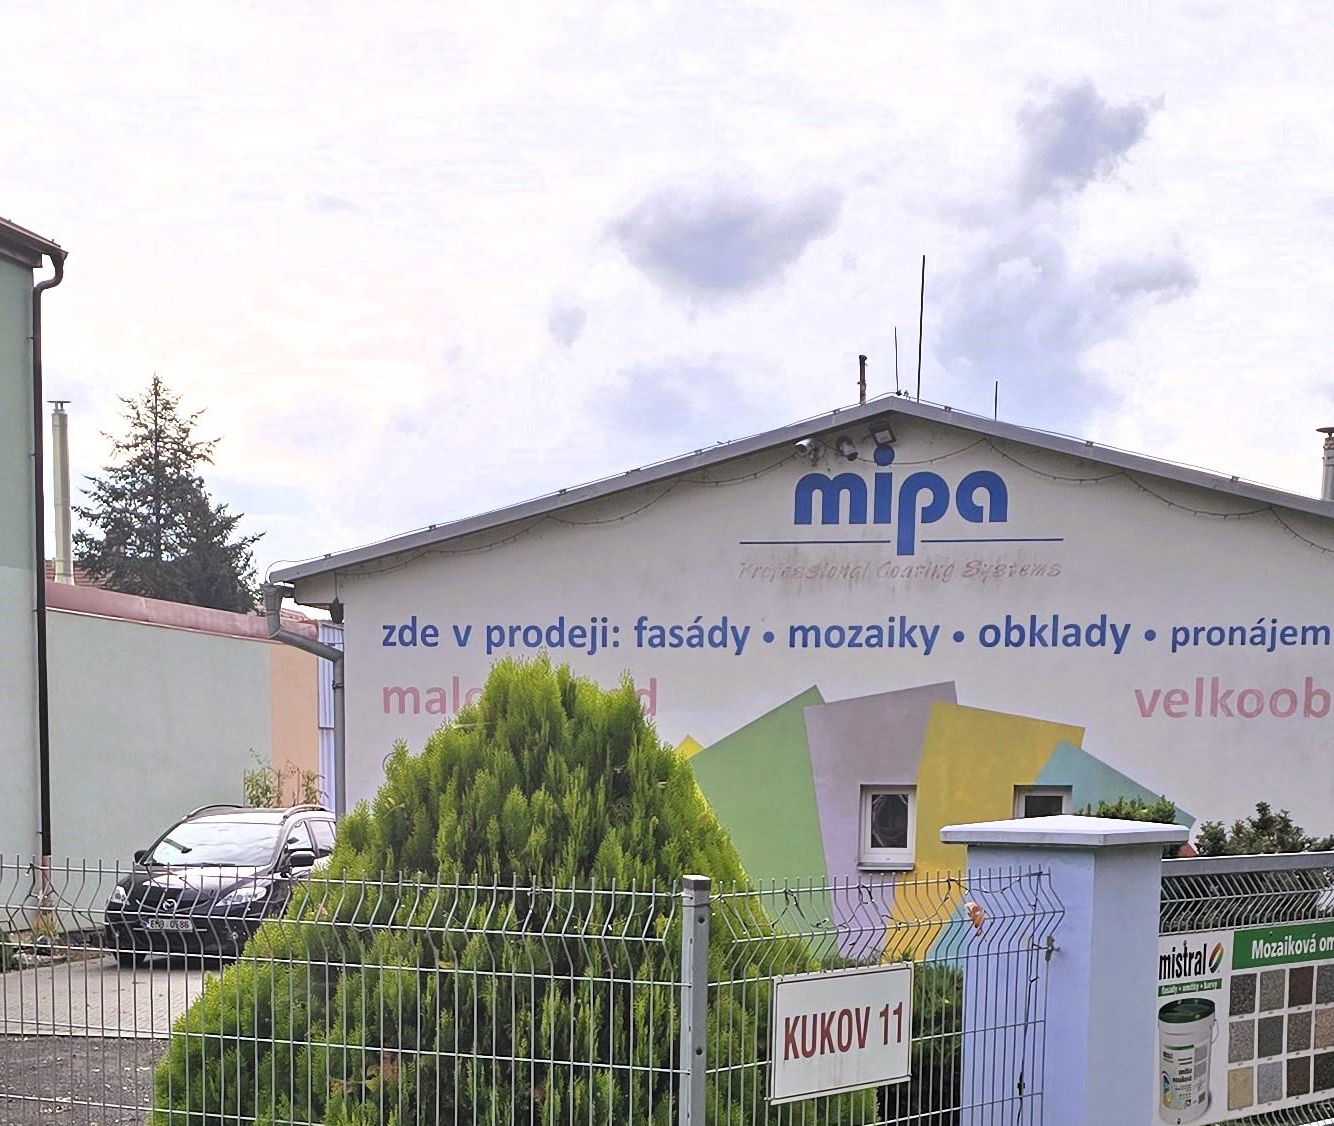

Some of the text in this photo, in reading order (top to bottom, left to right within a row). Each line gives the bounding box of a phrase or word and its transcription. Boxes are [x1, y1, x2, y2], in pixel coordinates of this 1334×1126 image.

[794, 444, 1008, 556] mipa
[876, 560, 956, 583] Coating
[962, 559, 1062, 583] Systems
[382, 615, 439, 647] zde
[452, 624, 472, 648] v
[486, 616, 621, 655] prodeji:
[634, 615, 750, 655] fasády
[789, 615, 940, 655] mozaiky
[979, 614, 1131, 654] obklady
[1171, 618, 1331, 653] pronájem
[1158, 943, 1207, 980] mistral
[1251, 933, 1316, 960] Mozaiková
[784, 1001, 903, 1061] KUKOV 11
